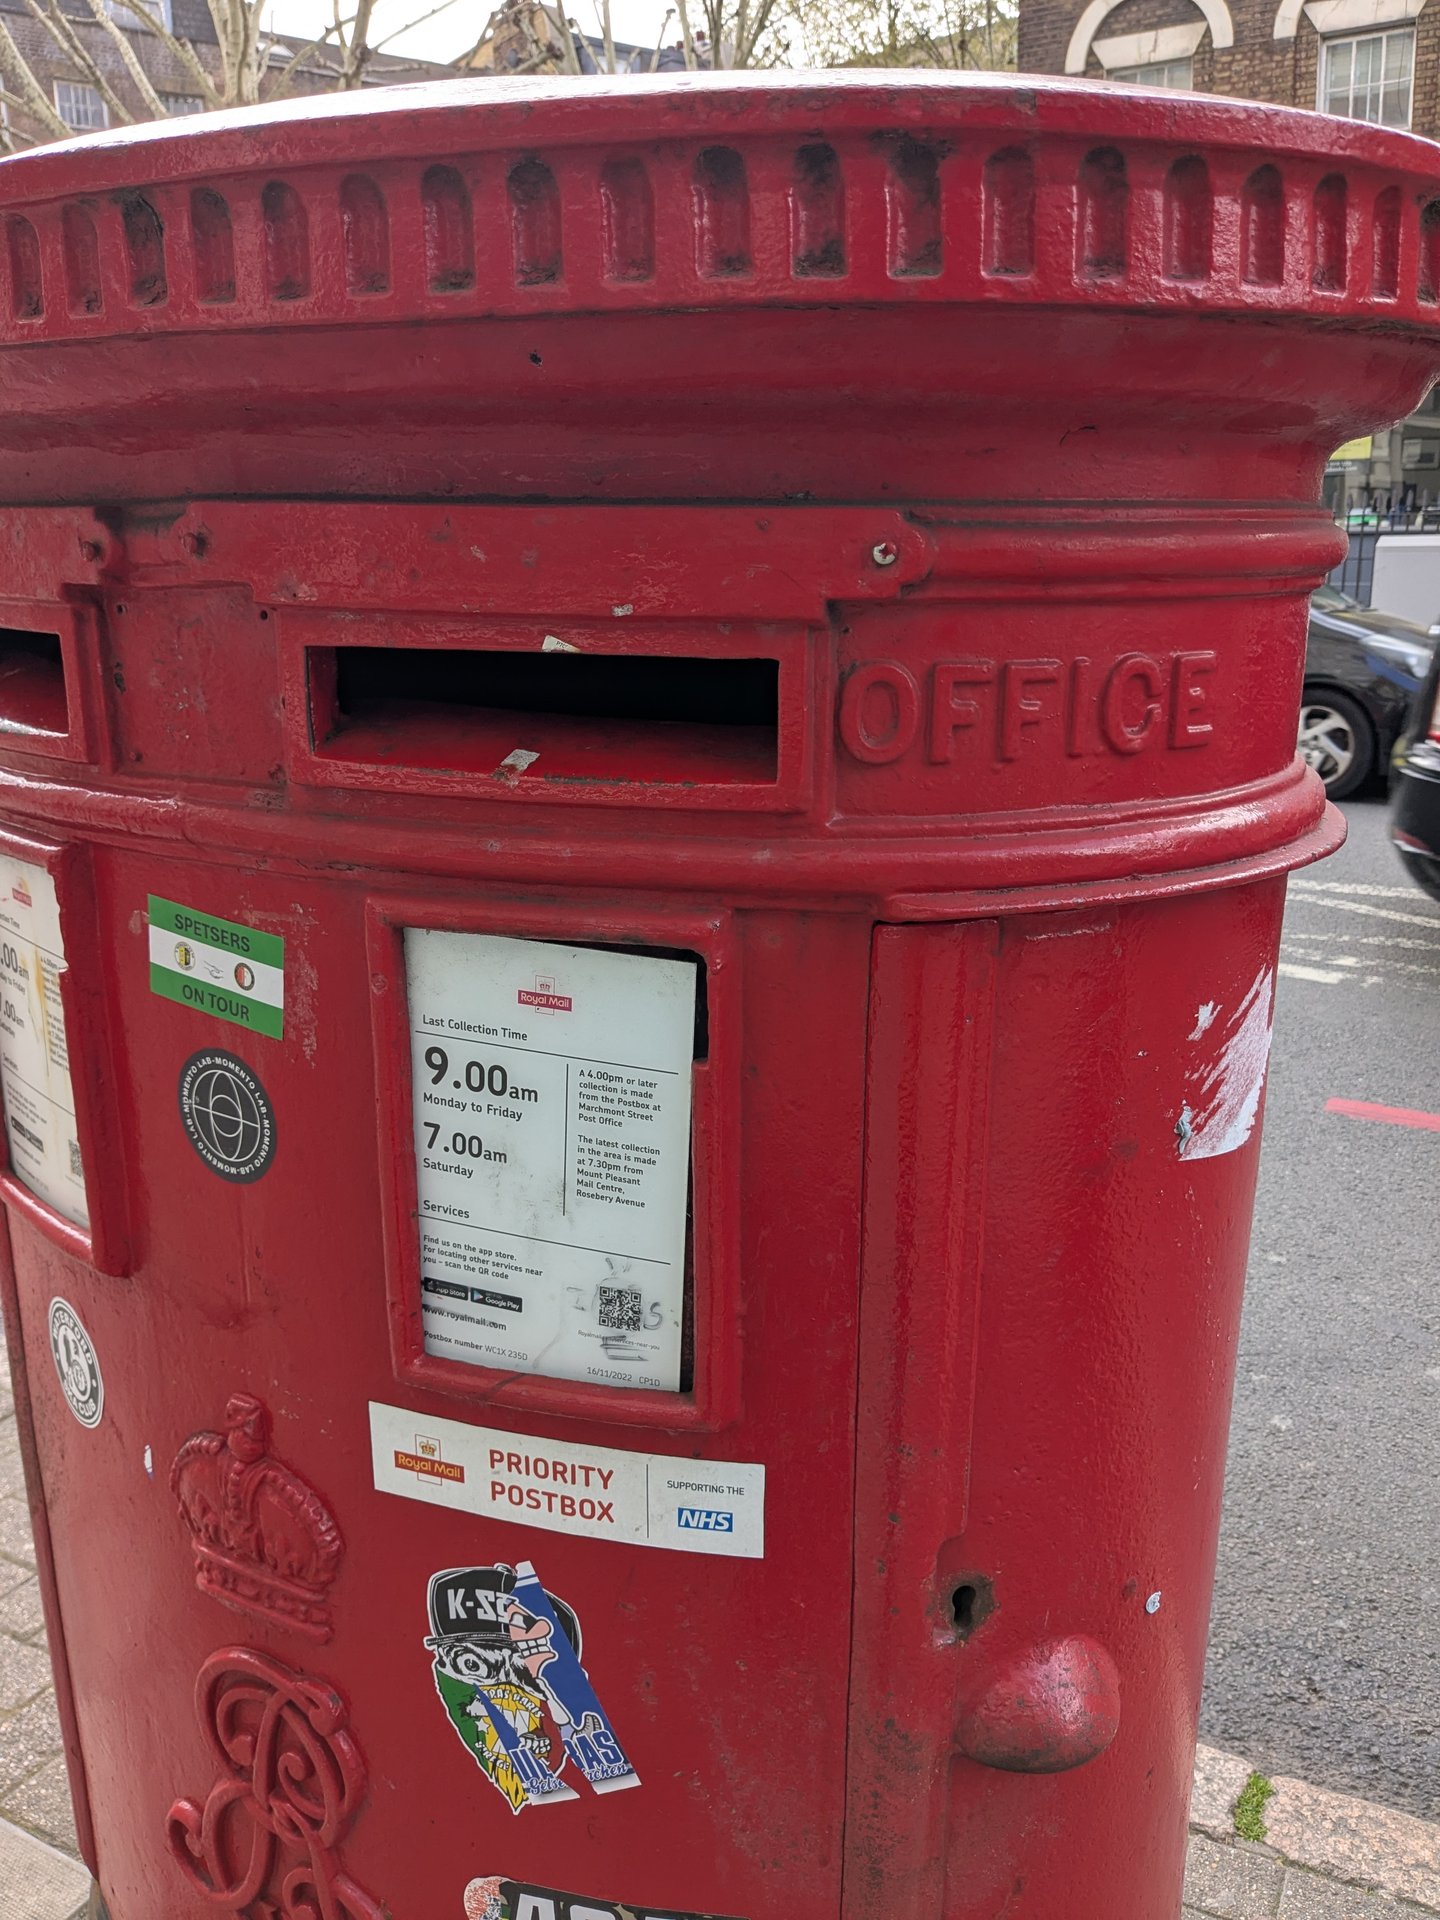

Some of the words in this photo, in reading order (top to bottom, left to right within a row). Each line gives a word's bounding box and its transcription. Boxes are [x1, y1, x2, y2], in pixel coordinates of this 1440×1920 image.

[834, 650, 1216, 765] OFFICE
[174, 914, 250, 952] SPETSERS
[182, 984, 204, 1006] ON
[208, 992, 250, 1022] TOUR
[520, 992, 546, 1005] Royal
[549, 996, 569, 1008] Mail
[423, 1014, 444, 1028] Last
[448, 1019, 497, 1036] Collection
[501, 1027, 527, 1041] Time
[425, 1047, 538, 1102] 9.00am
[579, 1069, 585, 1077] A
[587, 1069, 623, 1085] 4.00pm
[626, 1077, 635, 1085] or
[638, 1079, 657, 1089] later
[579, 1081, 618, 1094] collection
[631, 1088, 653, 1099] made
[423, 1092, 467, 1111] Monday
[471, 1102, 482, 1113] to
[487, 1104, 522, 1121] Friday
[579, 1092, 598, 1102] from
[602, 1095, 614, 1104] the
[617, 1097, 649, 1110] Postbox
[652, 1103, 661, 1111] at
[579, 1103, 625, 1117] Marchmont
[627, 1110, 653, 1121] Street
[579, 1114, 595, 1124] Post
[599, 1117, 623, 1128] Office
[423, 1122, 507, 1164] 7.00am
[578, 1135, 593, 1145] The
[595, 1138, 618, 1149] latest
[621, 1142, 660, 1156] collection
[577, 1145, 584, 1154] in
[587, 1147, 600, 1157] the
[603, 1151, 621, 1160] area
[625, 1152, 631, 1161] is
[634, 1154, 656, 1166] made
[577, 1157, 585, 1166] at
[588, 1158, 621, 1172] 7.30pm
[624, 1163, 644, 1175] from
[423, 1158, 474, 1178] Saturday
[577, 1168, 603, 1179] Mount
[605, 1171, 640, 1186] Pleasant
[576, 1179, 594, 1189] Mail
[596, 1181, 625, 1194] Centre,
[423, 1200, 470, 1219] Services
[576, 1190, 613, 1204] Rosebery
[616, 1196, 645, 1208] Avenue
[423, 1235, 439, 1245] Find
[442, 1239, 450, 1247] us
[452, 1241, 461, 1249] on
[464, 1242, 477, 1252] the
[479, 1247, 492, 1257] app
[495, 1250, 516, 1261] store.
[423, 1245, 435, 1255] For
[437, 1247, 467, 1261] locating
[470, 1254, 489, 1265] other
[491, 1259, 522, 1272] services
[525, 1267, 543, 1277] near
[423, 1255, 436, 1266] you
[445, 1261, 461, 1270] scan
[464, 1263, 476, 1274] the
[478, 1266, 489, 1276] QR
[491, 1270, 509, 1280] code
[423, 1307, 506, 1330] www.royalmail.com
[424, 1330, 452, 1343] Postbox
[455, 1339, 483, 1350] number
[485, 1345, 506, 1356] WC1X
[587, 1367, 632, 1381] 16/11/2022
[397, 1453, 431, 1474] Royal
[434, 1462, 460, 1478] Mail
[489, 1449, 614, 1490] PRIORITY
[666, 1481, 724, 1495] SUPPORTING
[726, 1485, 745, 1496] THE
[491, 1481, 615, 1524] POSTBOX
[679, 1509, 732, 1530] NHS
